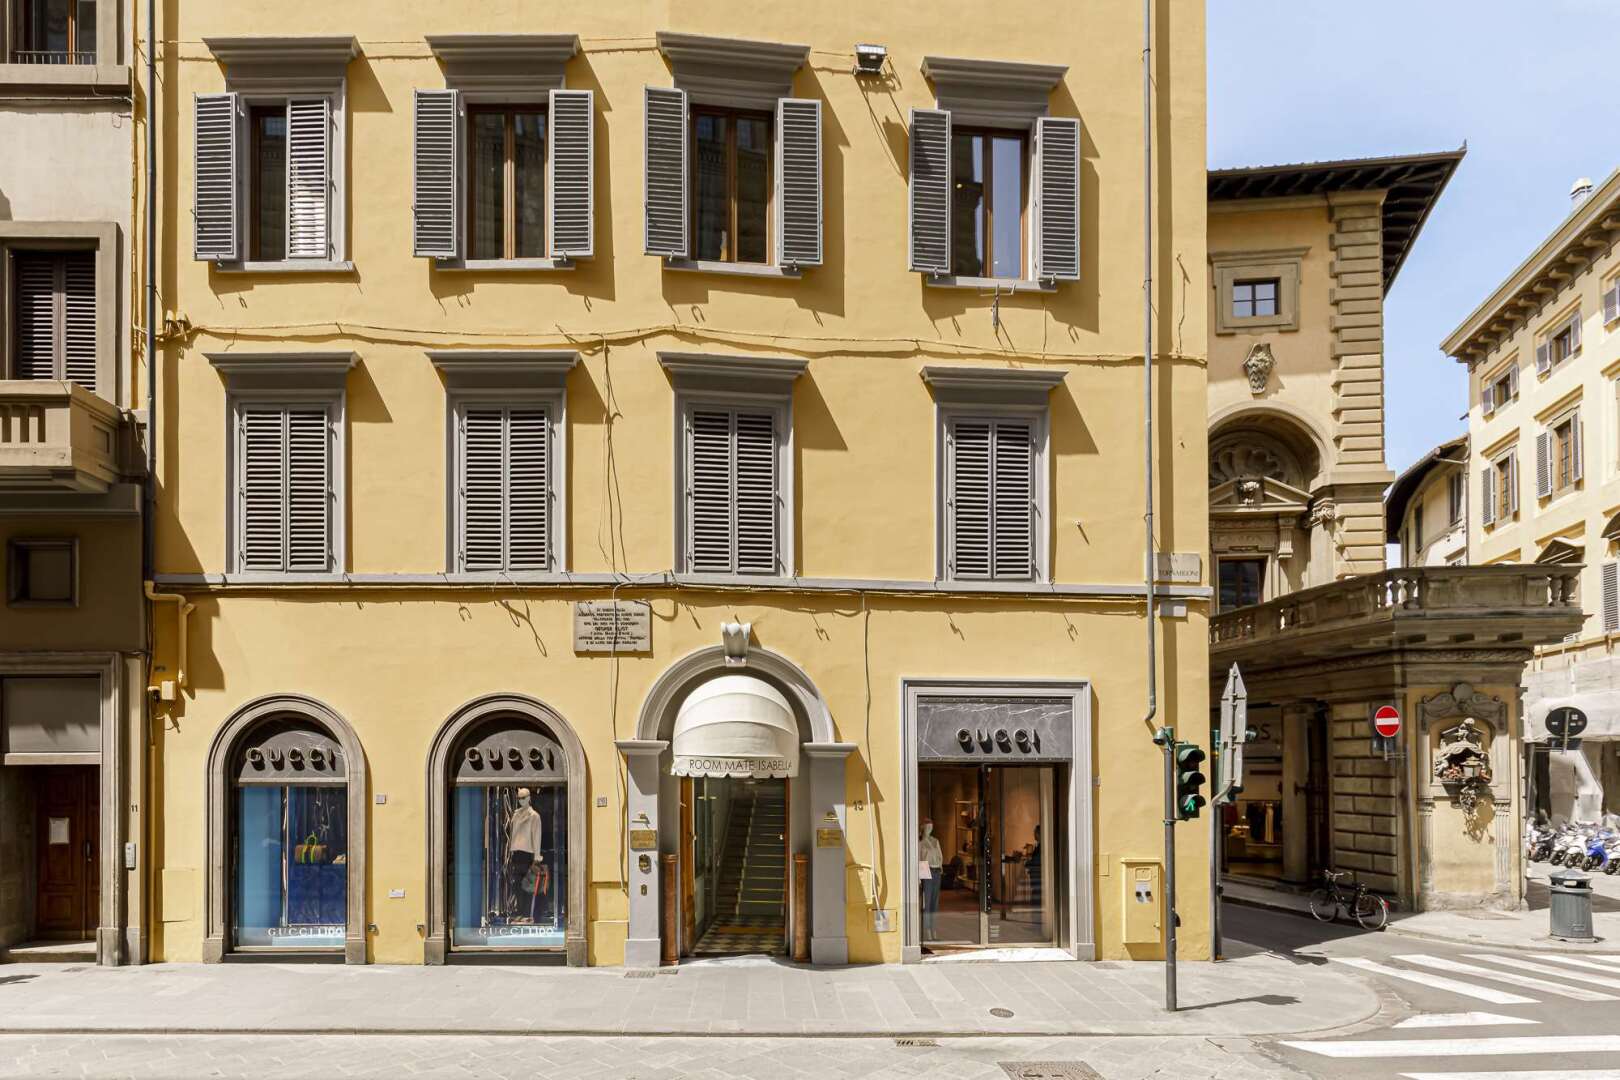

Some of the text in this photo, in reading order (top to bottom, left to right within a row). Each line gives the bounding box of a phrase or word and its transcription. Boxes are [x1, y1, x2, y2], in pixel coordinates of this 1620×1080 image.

[955, 728, 1037, 745] GUCCI
[245, 747, 334, 764] GUCCI
[464, 746, 553, 764] GUCCI
[689, 759, 793, 771] ROOM MATE ISABELLA
[267, 926, 313, 937] GUCCI
[478, 926, 524, 937] GUCCI
